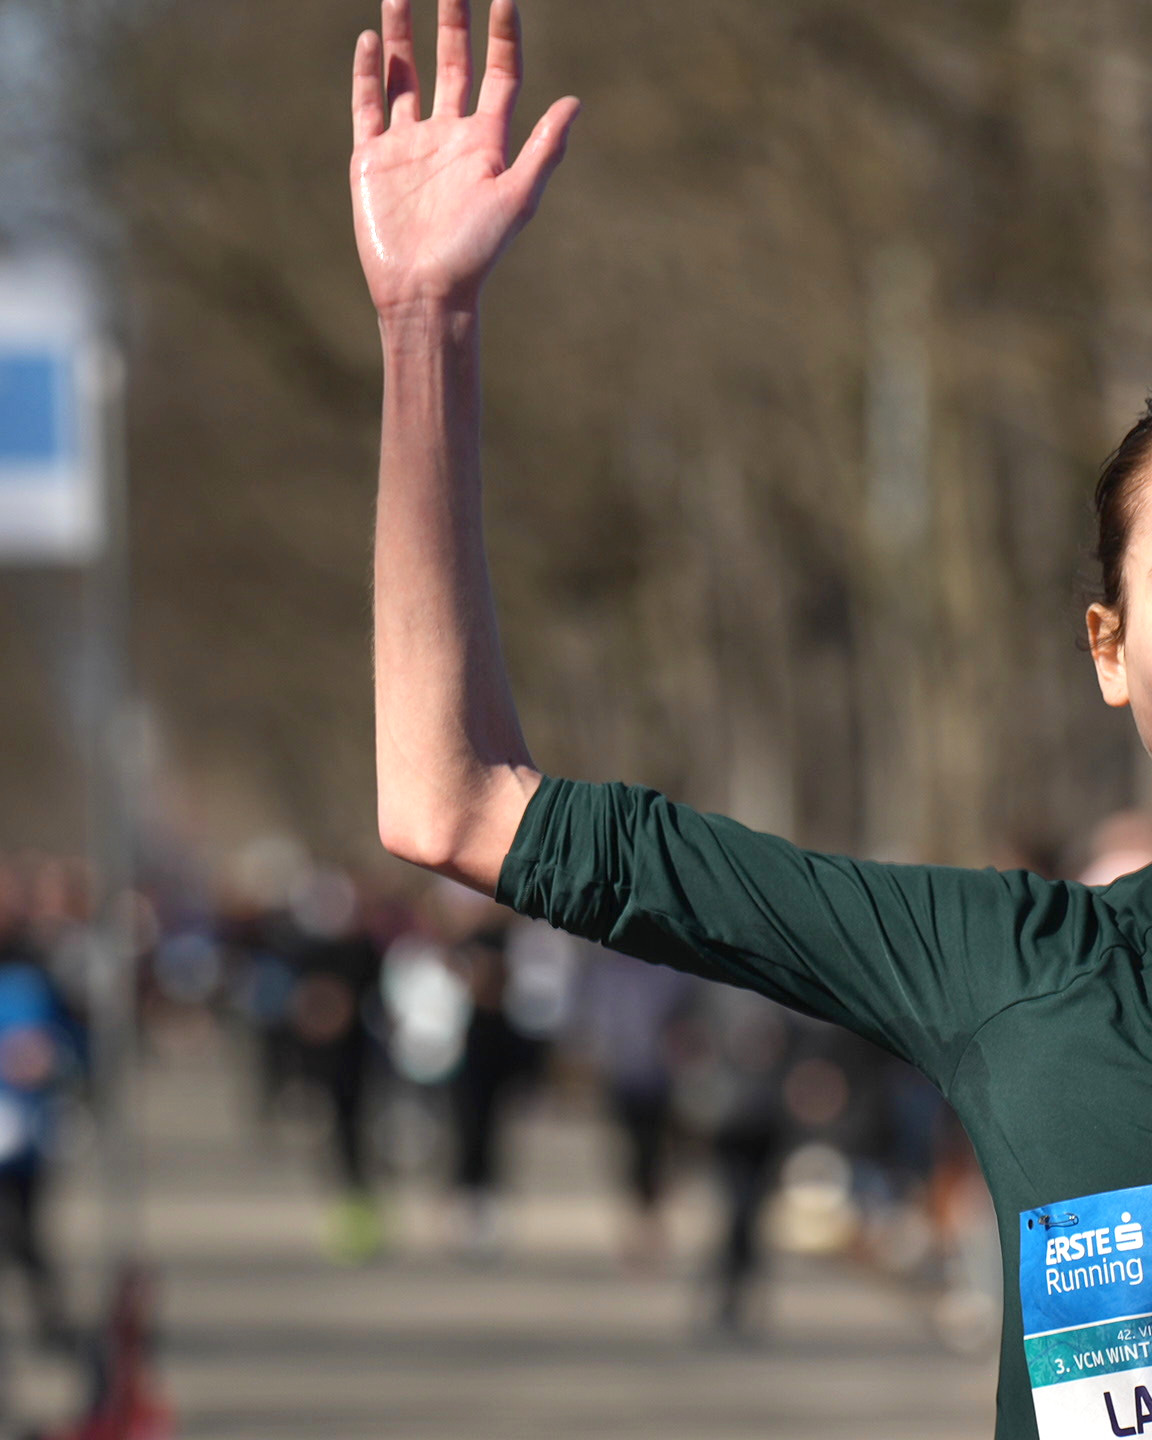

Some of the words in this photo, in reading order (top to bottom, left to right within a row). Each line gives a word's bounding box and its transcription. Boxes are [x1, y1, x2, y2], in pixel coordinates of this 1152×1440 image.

[1046, 1227, 1112, 1265] ERSTE
[1045, 1257, 1144, 1296] Running
[1117, 1328, 1136, 1342] 42.
[1054, 1358, 1071, 1374] 3.
[1073, 1350, 1105, 1371] VCM
